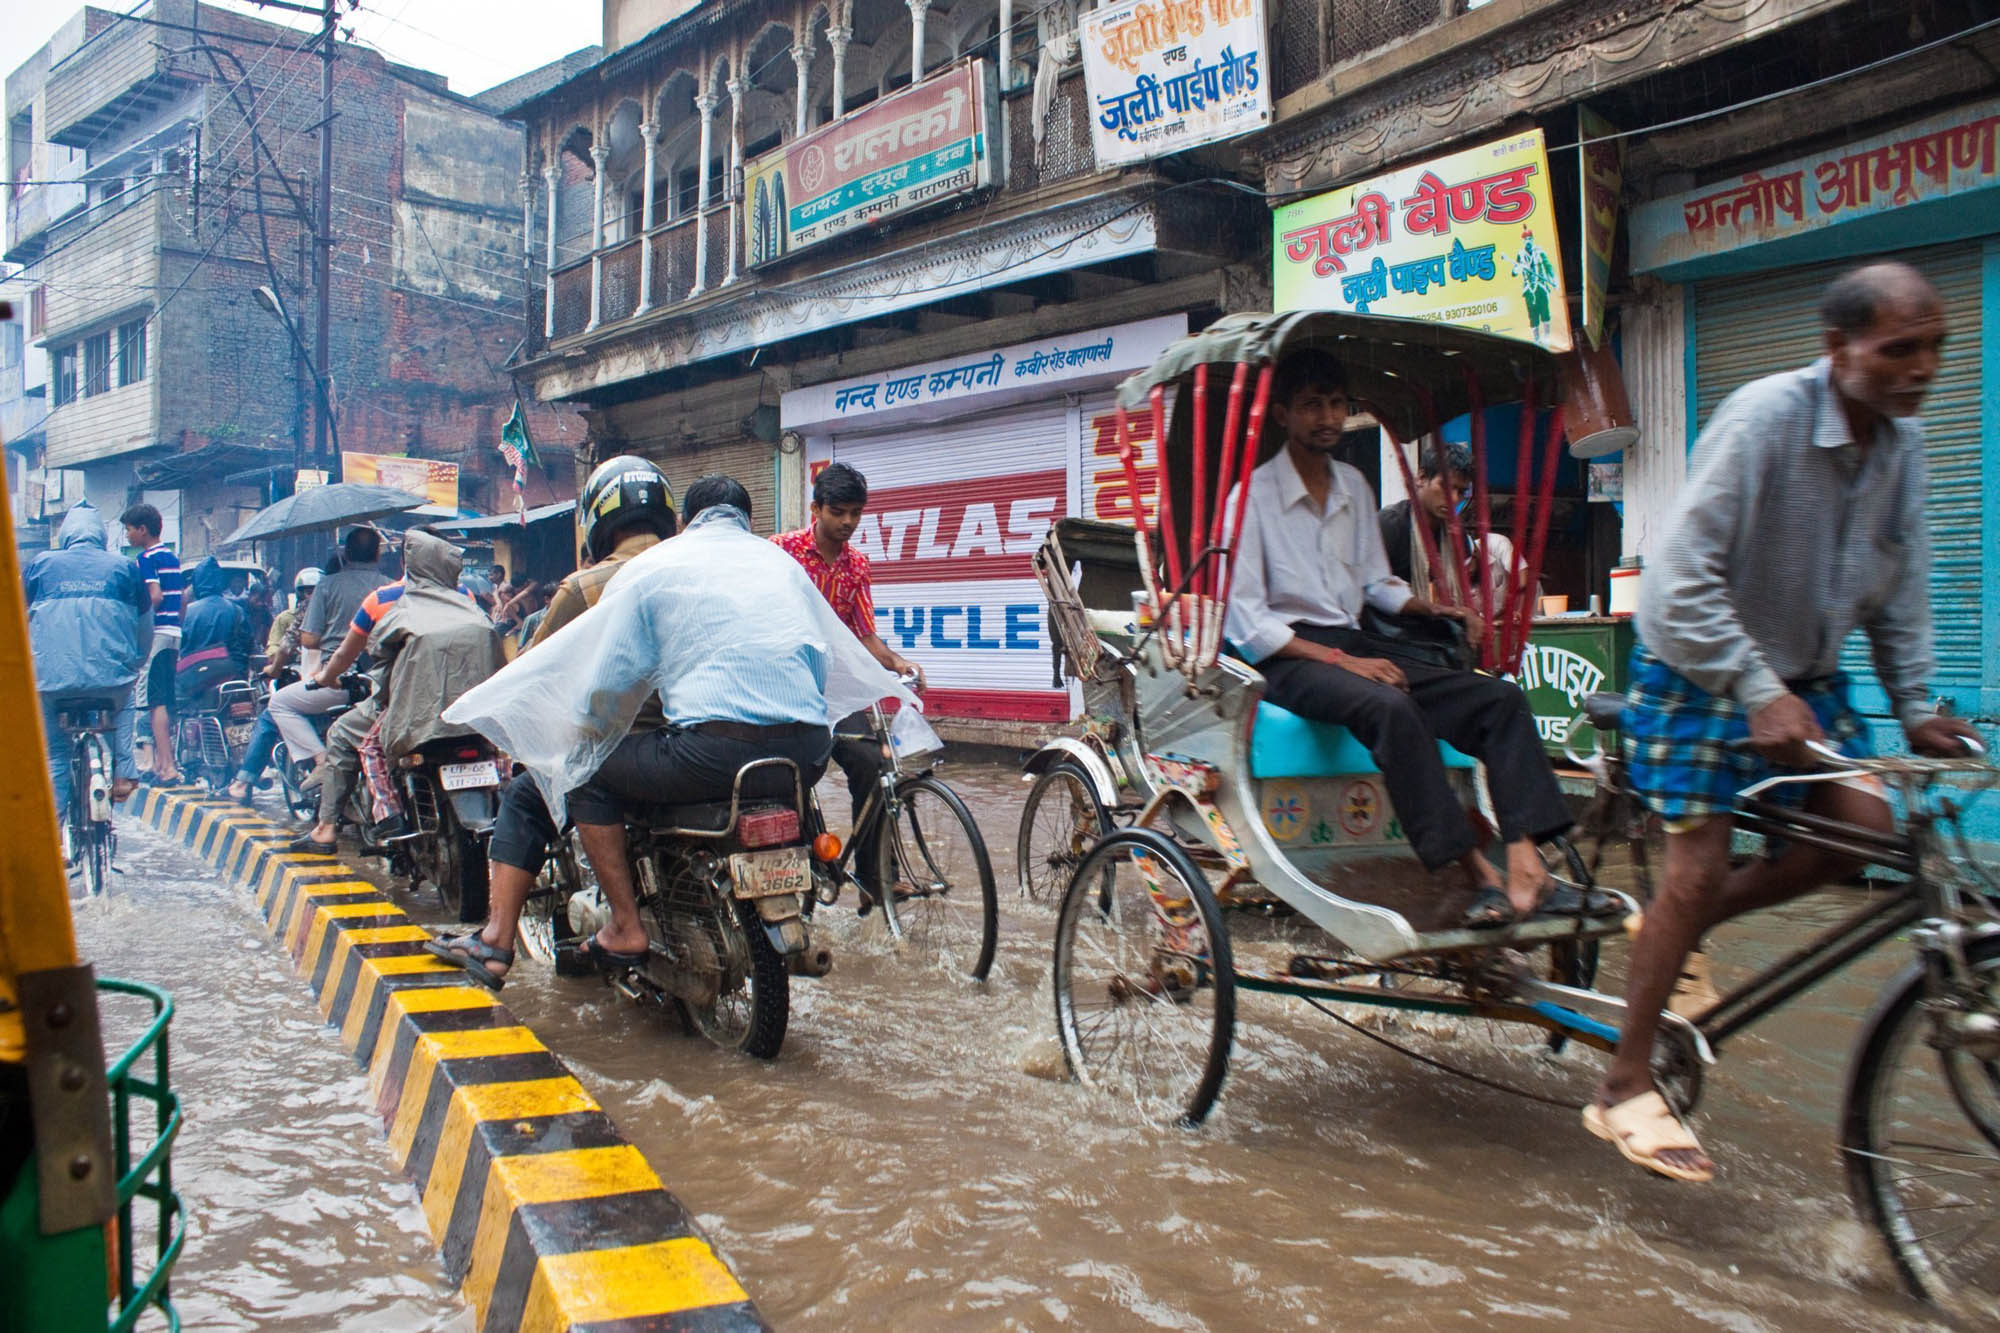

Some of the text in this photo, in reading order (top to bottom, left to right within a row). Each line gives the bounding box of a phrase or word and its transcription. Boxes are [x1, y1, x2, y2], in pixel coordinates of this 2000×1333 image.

[834, 87, 967, 171] रालको
[795, 170, 971, 243] नन्द एण्ड कम्पनी वाराणसी
[800, 143, 968, 218] टायर ट्यूब हब
[1281, 191, 1394, 277] जूली
[1341, 256, 1390, 313] जूली
[1390, 255, 1445, 295] पाइप
[1445, 302, 1498, 320] 9307320106
[835, 384, 877, 413] नन्द
[885, 374, 926, 405] एण्ड
[929, 353, 1006, 398] कम्पनी
[1014, 354, 1051, 378] कबीर
[1066, 337, 1113, 368] वाराणसी
[850, 497, 1058, 562] ATLAS
[1540, 646, 1605, 708] पाइप
[762, 876, 804, 891] 3662
